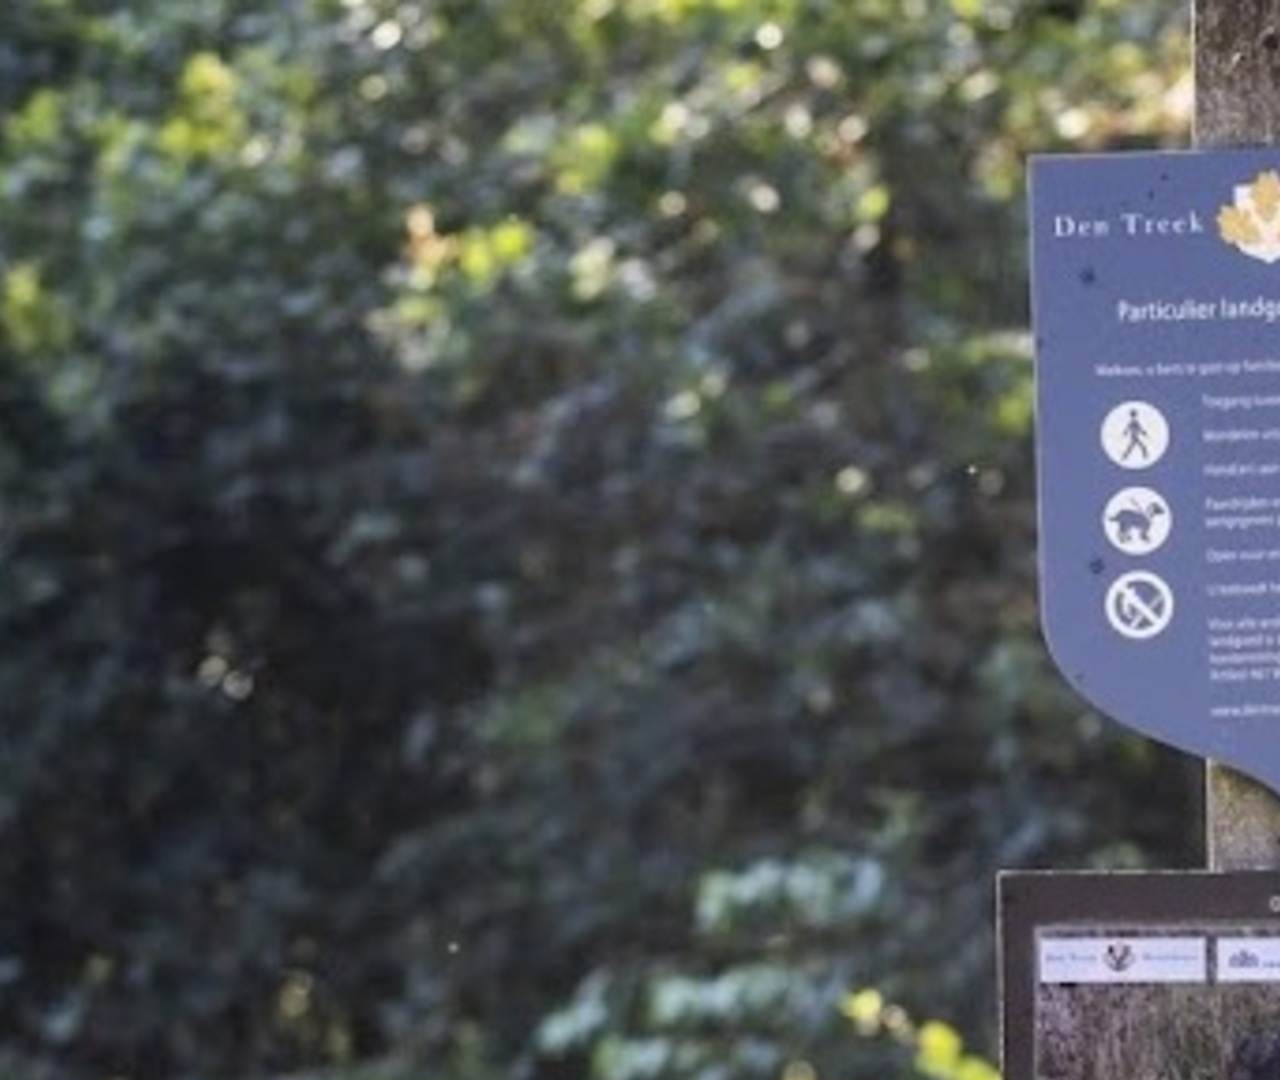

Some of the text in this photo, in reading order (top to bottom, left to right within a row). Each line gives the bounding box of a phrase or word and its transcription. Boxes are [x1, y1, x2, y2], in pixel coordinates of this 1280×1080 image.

[1054, 209, 1204, 237] Den Treek
[1118, 297, 1217, 324] Particulier
